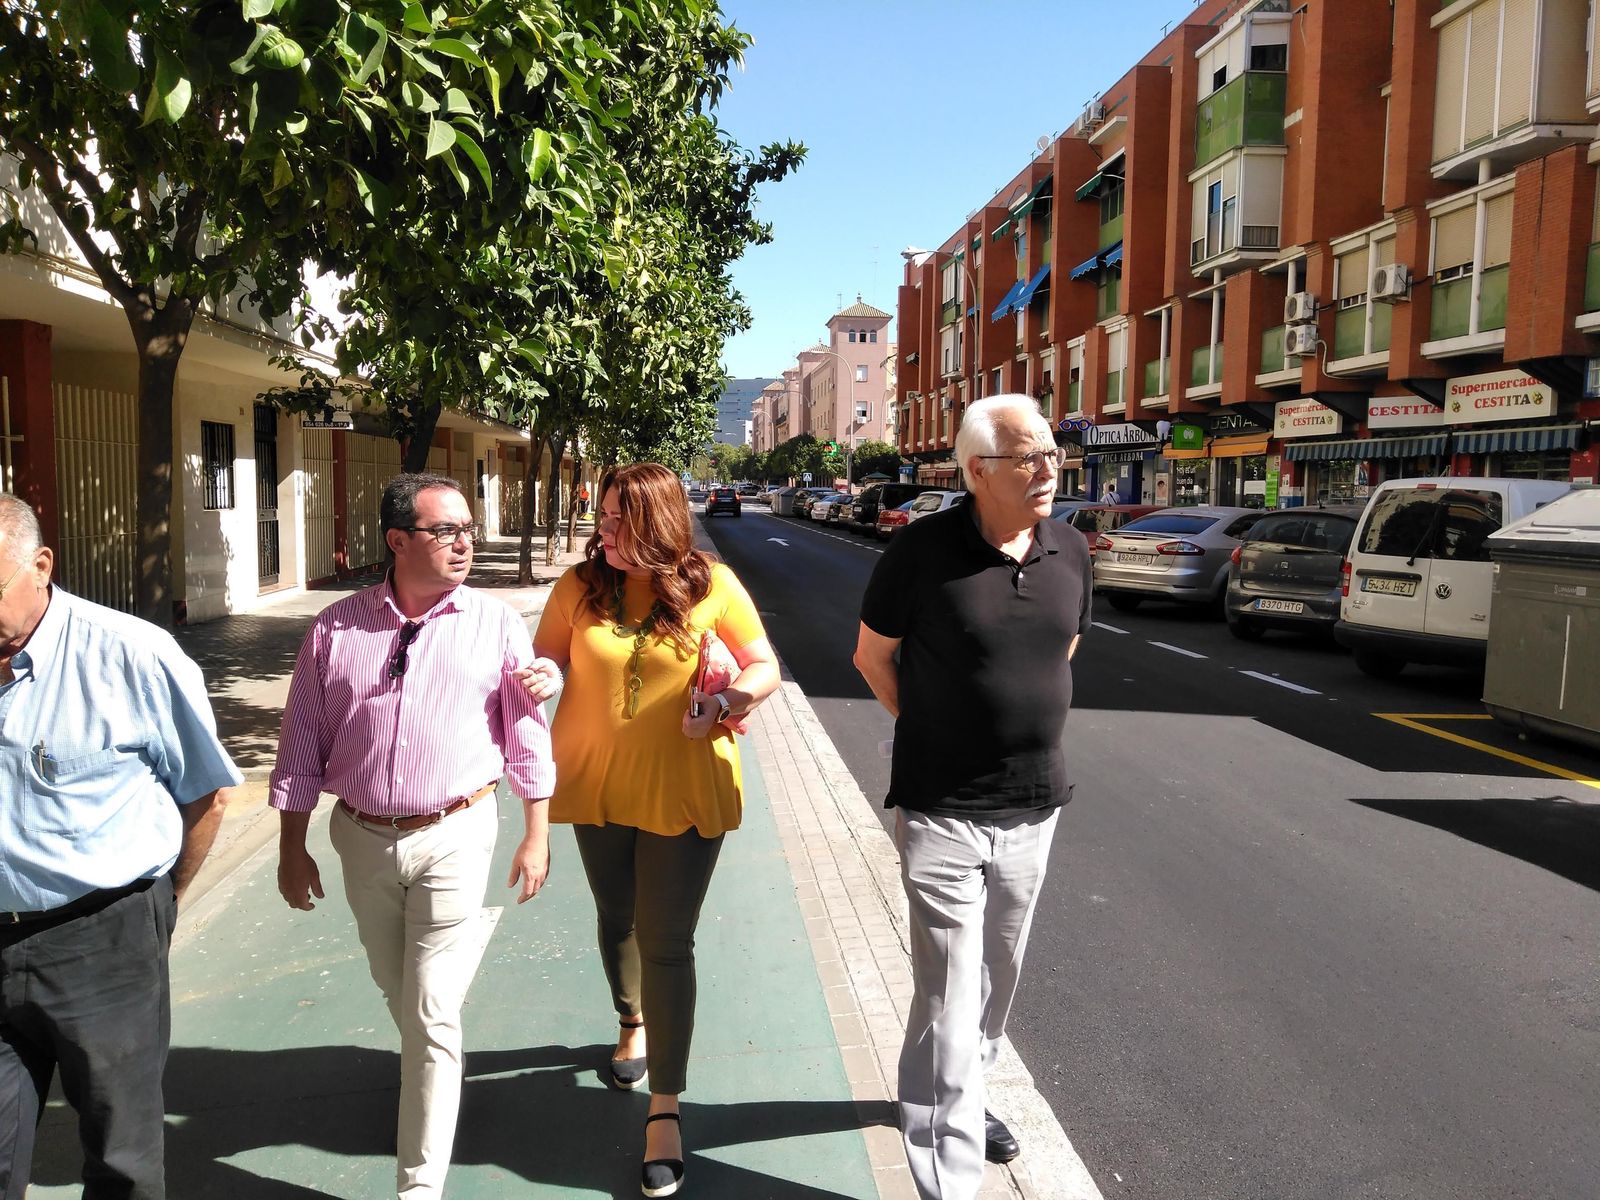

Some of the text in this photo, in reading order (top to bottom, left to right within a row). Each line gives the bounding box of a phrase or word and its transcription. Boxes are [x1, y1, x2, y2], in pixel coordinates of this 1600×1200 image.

[1451, 376, 1544, 397] Supermercado
[1474, 393, 1531, 409] CESTITA
[1279, 404, 1329, 417] Supermercad
[1369, 404, 1445, 417] CESTITA
[1292, 415, 1326, 427] CESTITA
[1090, 425, 1121, 445] OPTICA
[1368, 580, 1414, 594] 5434 HZT
[1260, 601, 1301, 612] 8370 HTG
